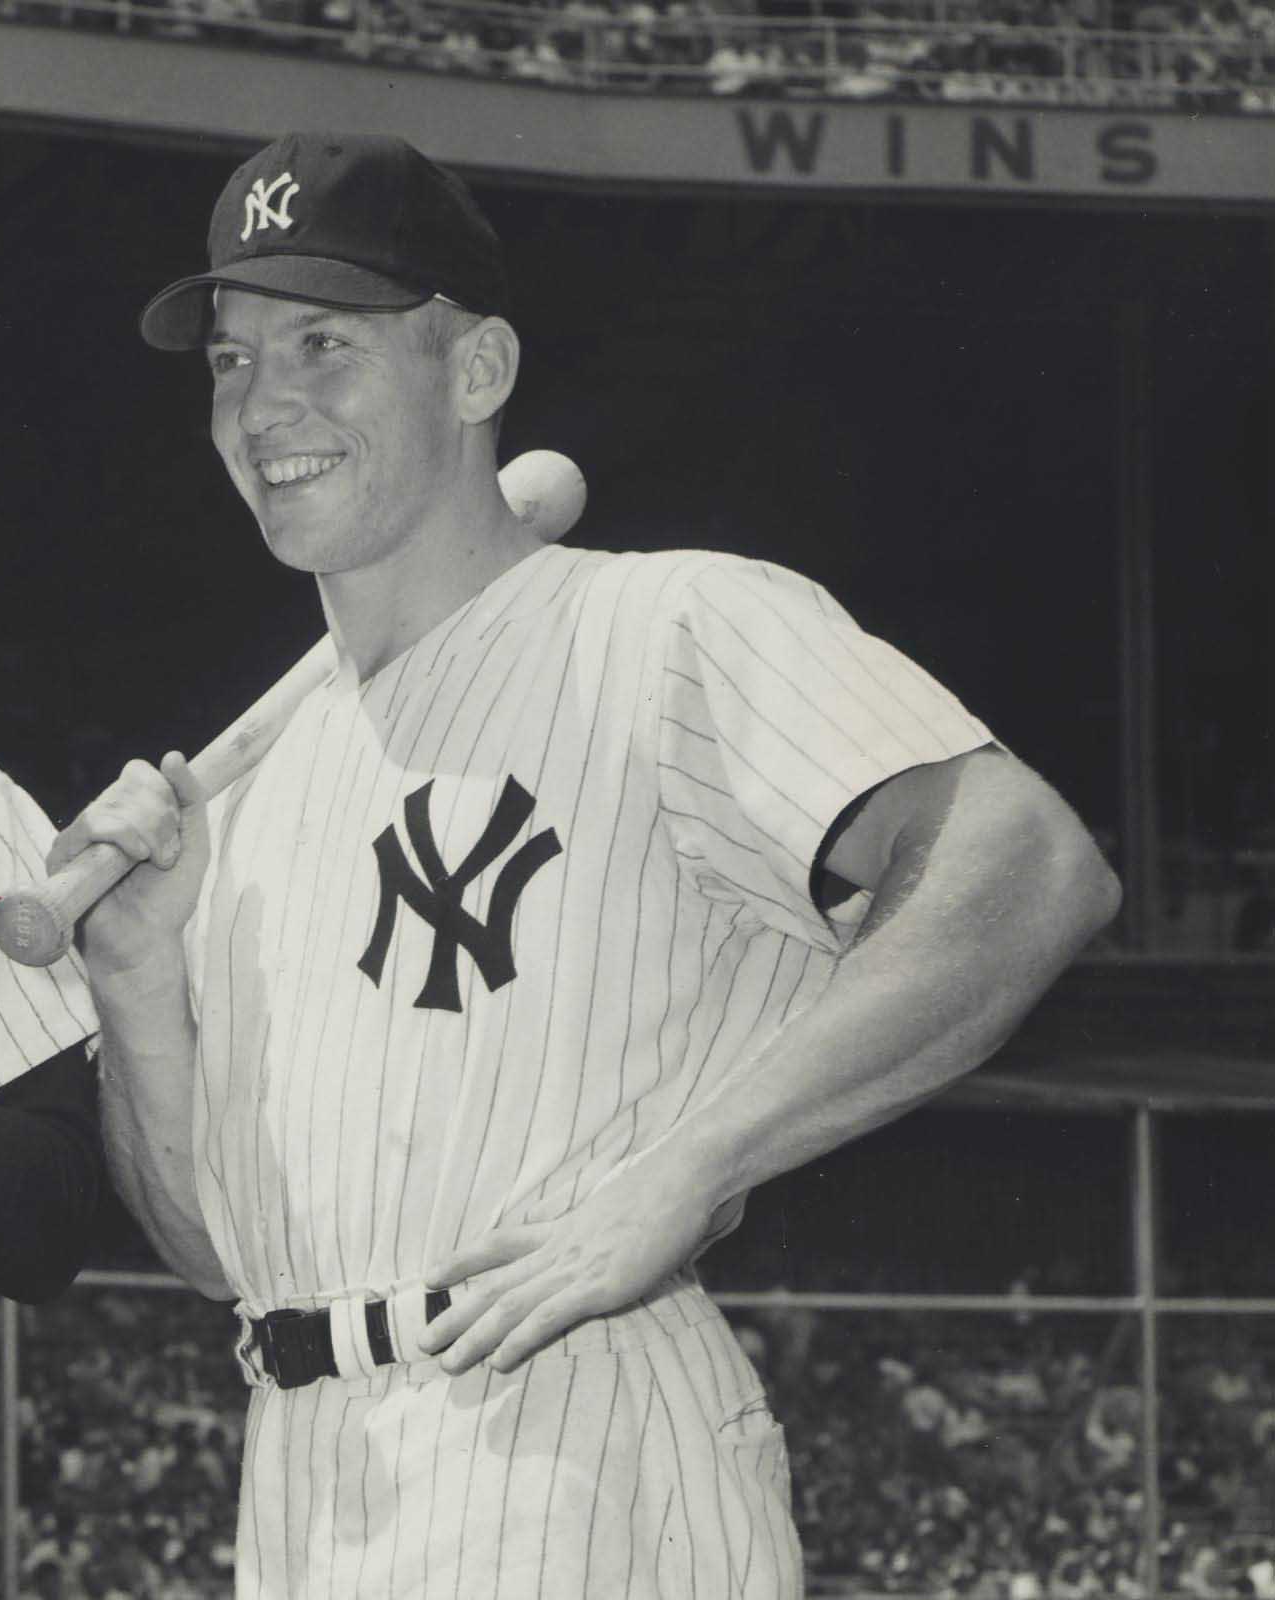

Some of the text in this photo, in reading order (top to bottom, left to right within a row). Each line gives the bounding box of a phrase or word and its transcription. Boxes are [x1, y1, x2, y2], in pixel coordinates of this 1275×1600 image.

[736, 109, 1158, 184] WINS
[240, 172, 301, 242] NY
[356, 772, 564, 1014] NY
